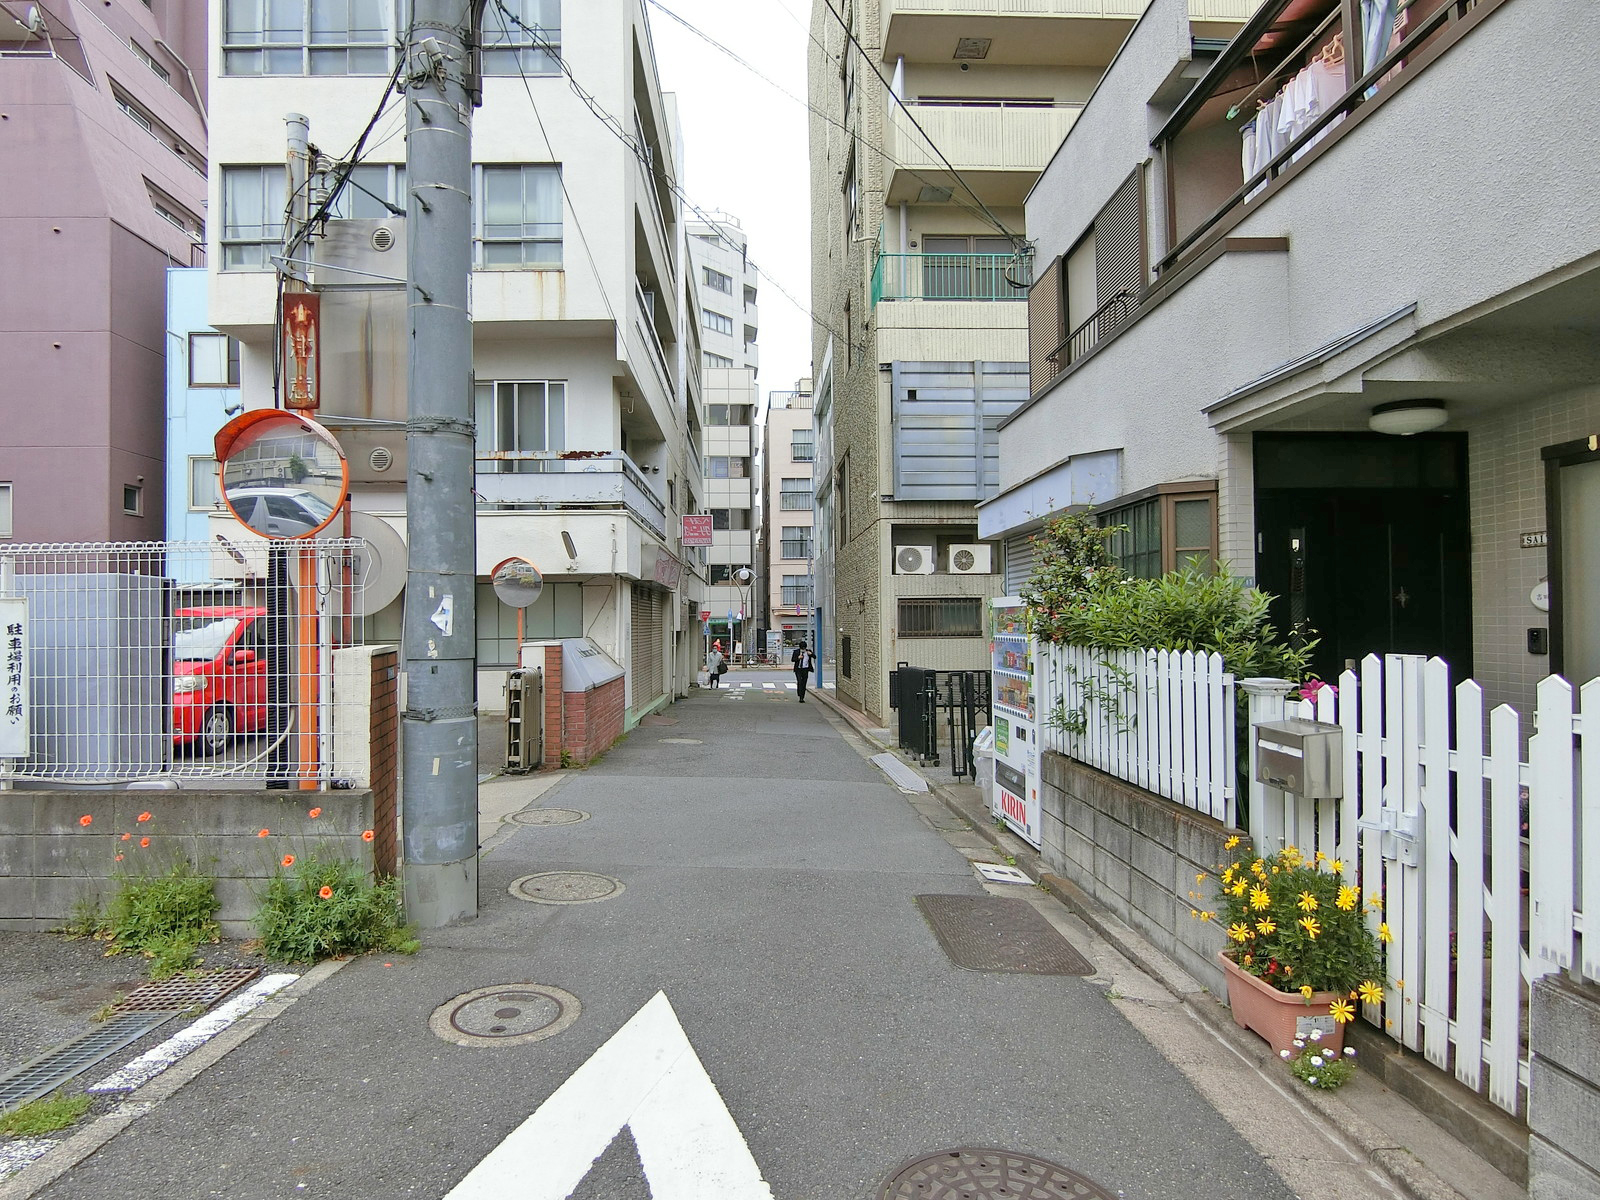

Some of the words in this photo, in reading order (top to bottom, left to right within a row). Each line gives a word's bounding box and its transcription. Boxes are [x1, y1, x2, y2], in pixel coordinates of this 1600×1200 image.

[1526, 534, 1547, 545] SAI
[5, 623, 24, 725] 駐車場利用のお願い
[1001, 789, 1027, 826] KIRIN
